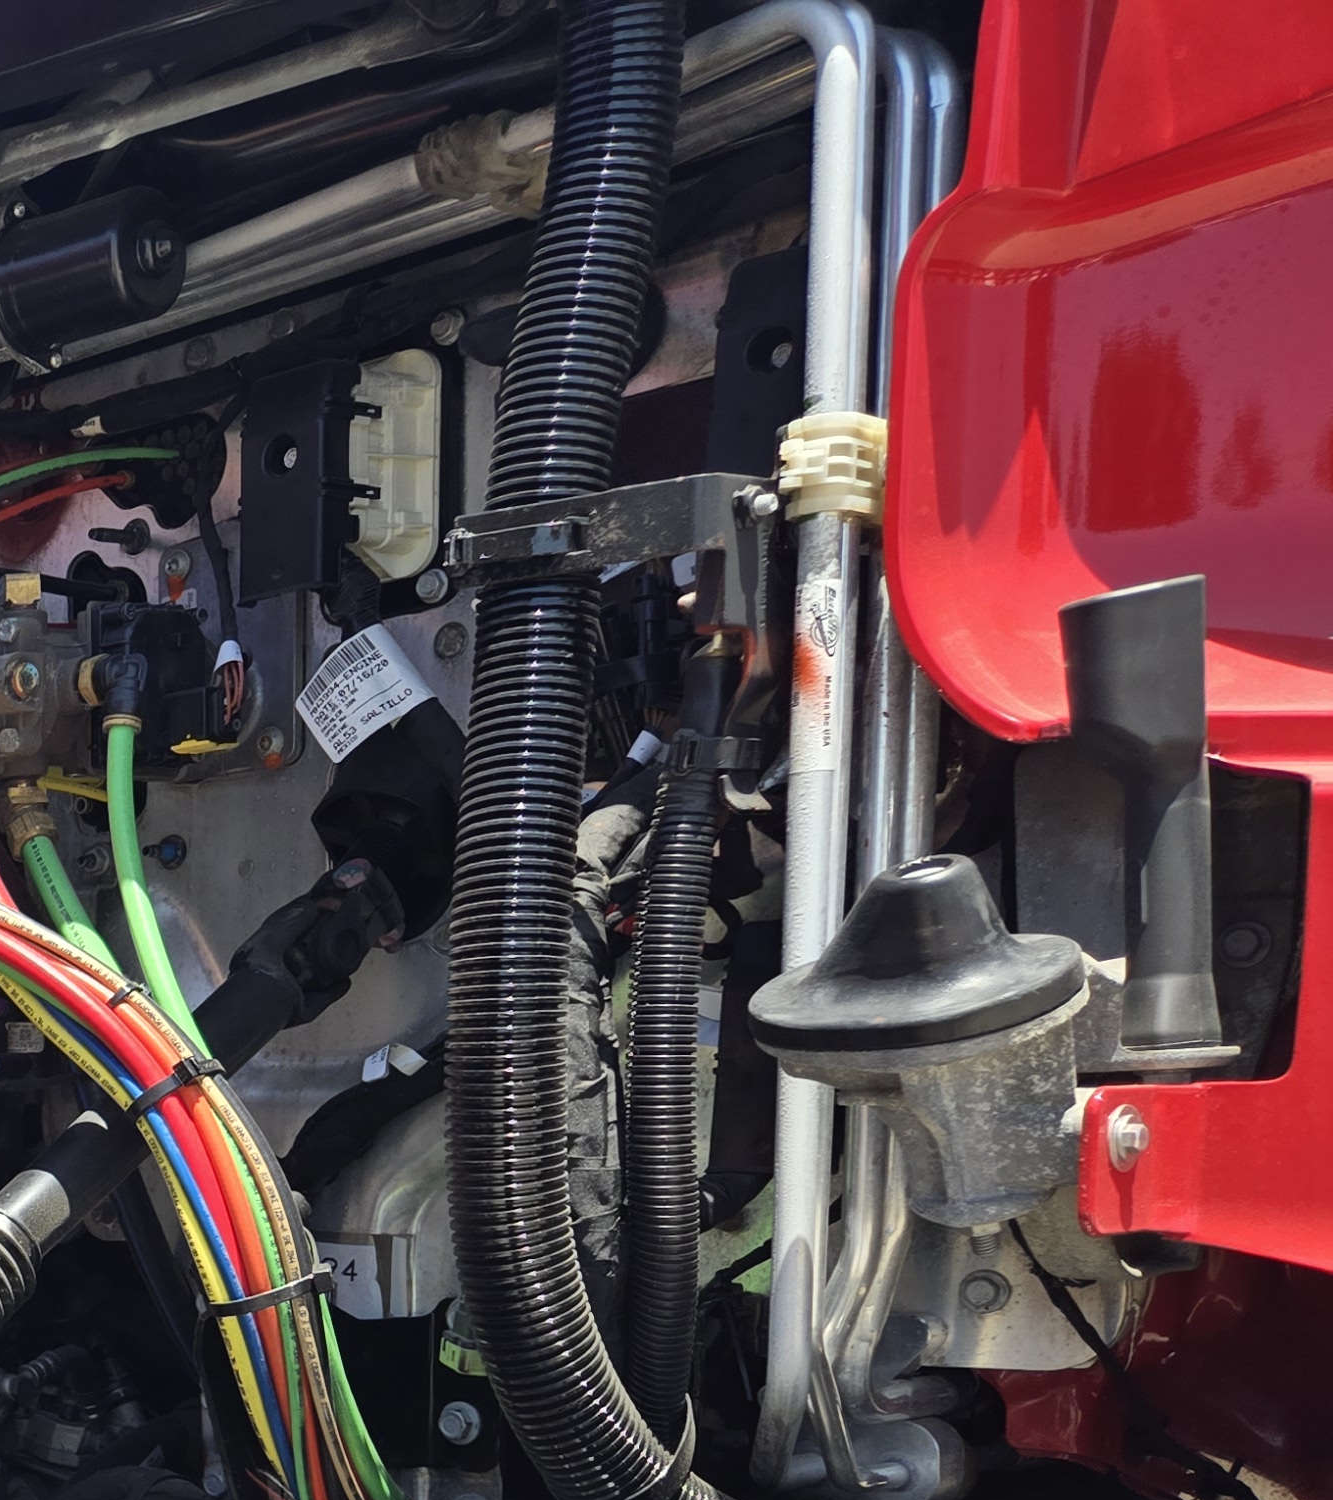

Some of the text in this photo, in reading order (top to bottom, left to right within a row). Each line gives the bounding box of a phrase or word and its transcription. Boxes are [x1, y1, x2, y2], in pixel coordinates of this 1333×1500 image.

[824, 676, 832, 699] Made
[360, 688, 413, 725] SALTILLO
[822, 729, 831, 747] USA
